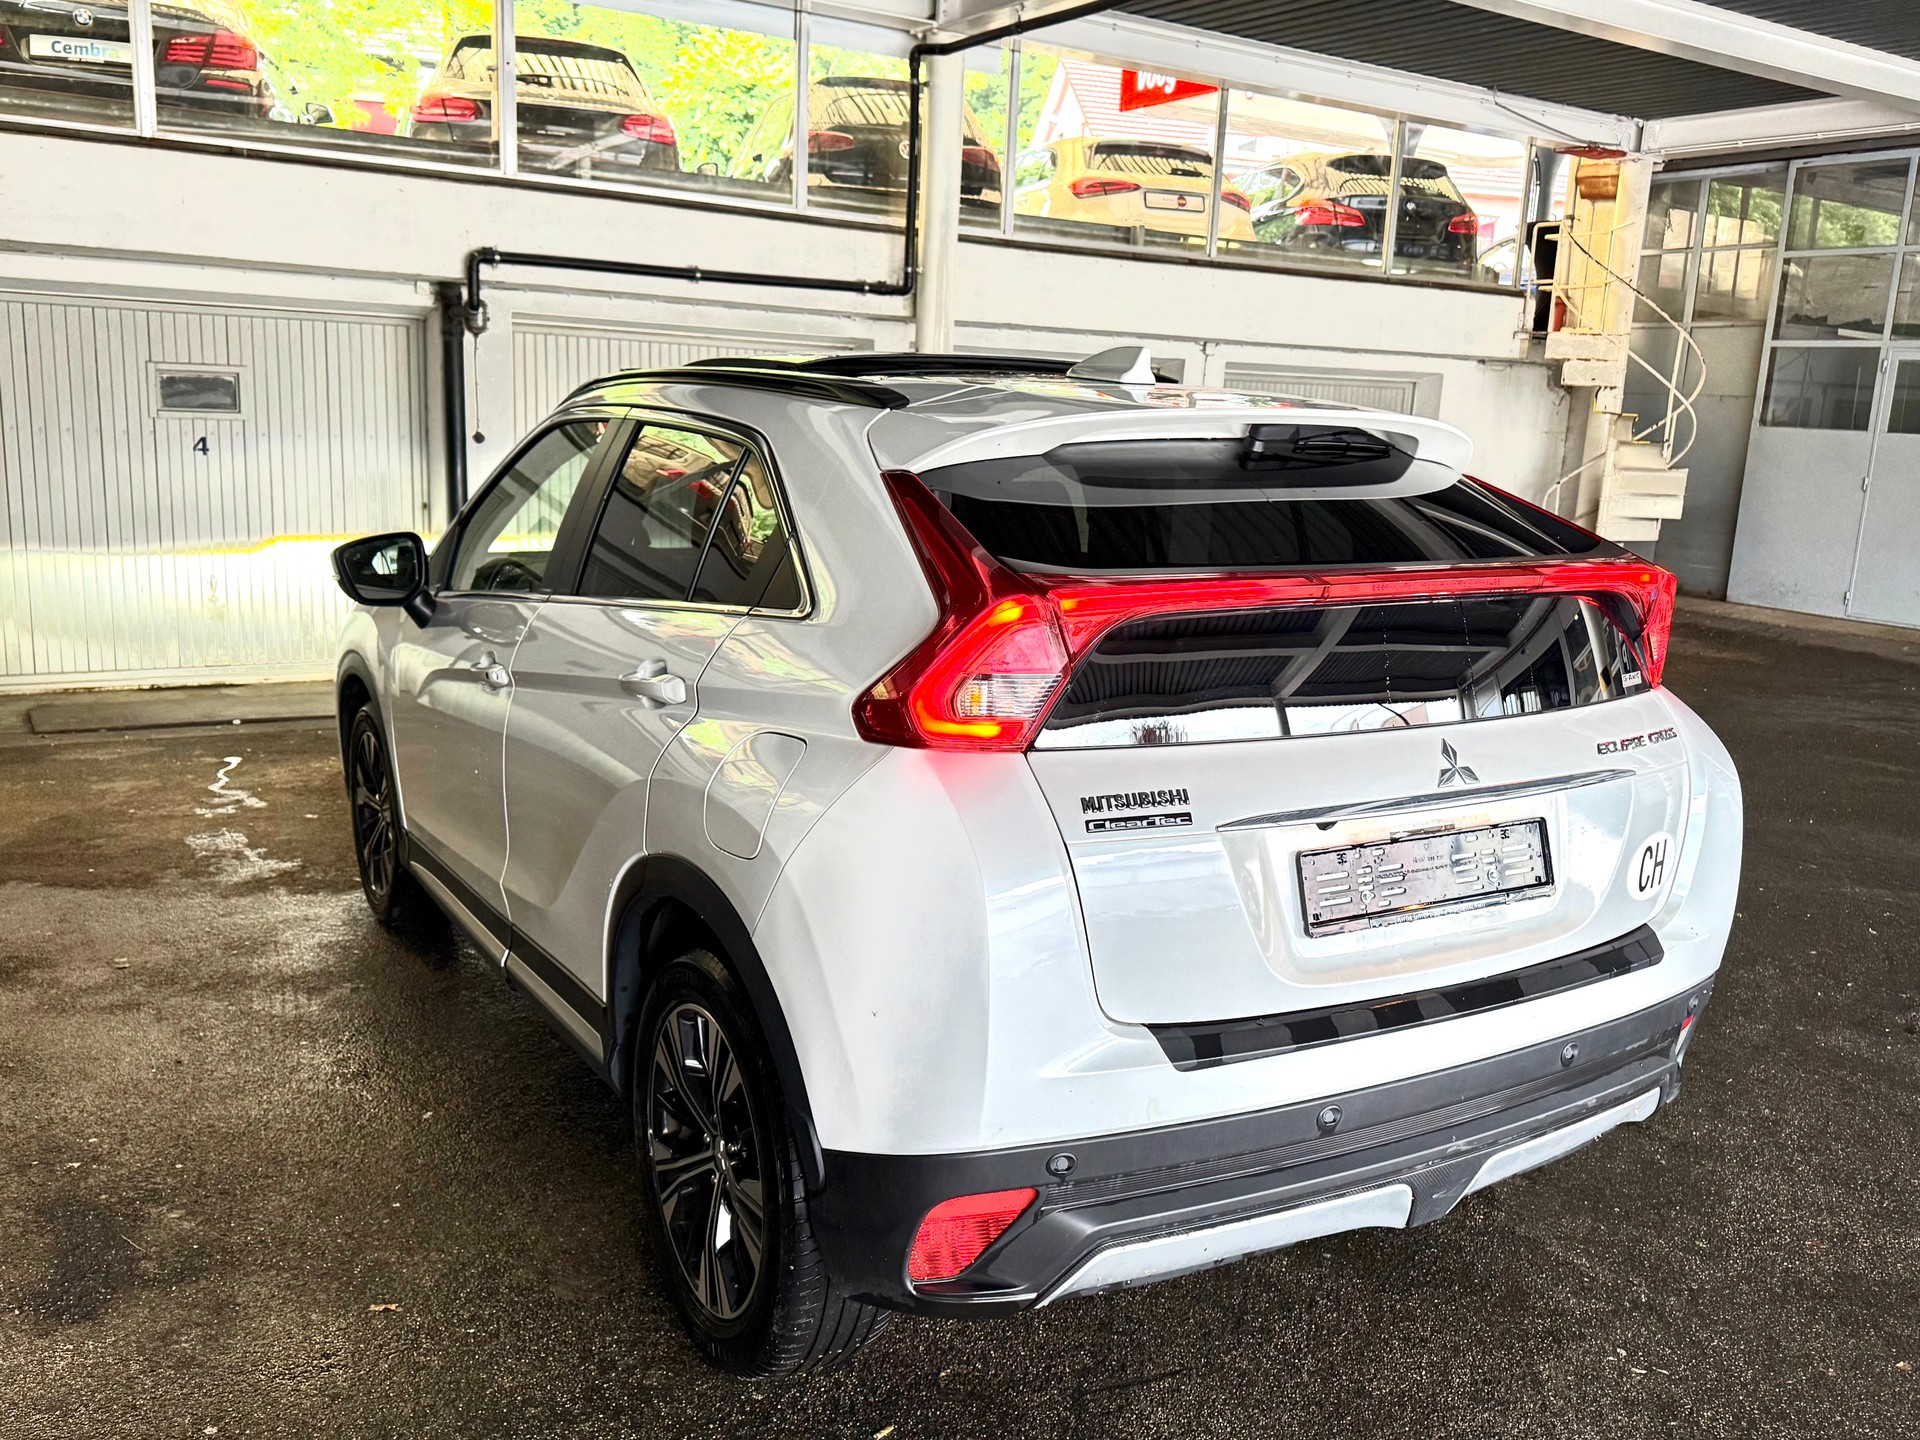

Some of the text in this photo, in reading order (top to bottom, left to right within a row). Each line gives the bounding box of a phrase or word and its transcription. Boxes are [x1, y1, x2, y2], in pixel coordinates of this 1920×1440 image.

[51, 40, 120, 59] Cembra
[193, 436, 210, 456] 4
[1080, 788, 1190, 814] MITSUBISHI
[1088, 816, 1192, 833] ClearTec
[1639, 838, 1667, 893] CH
